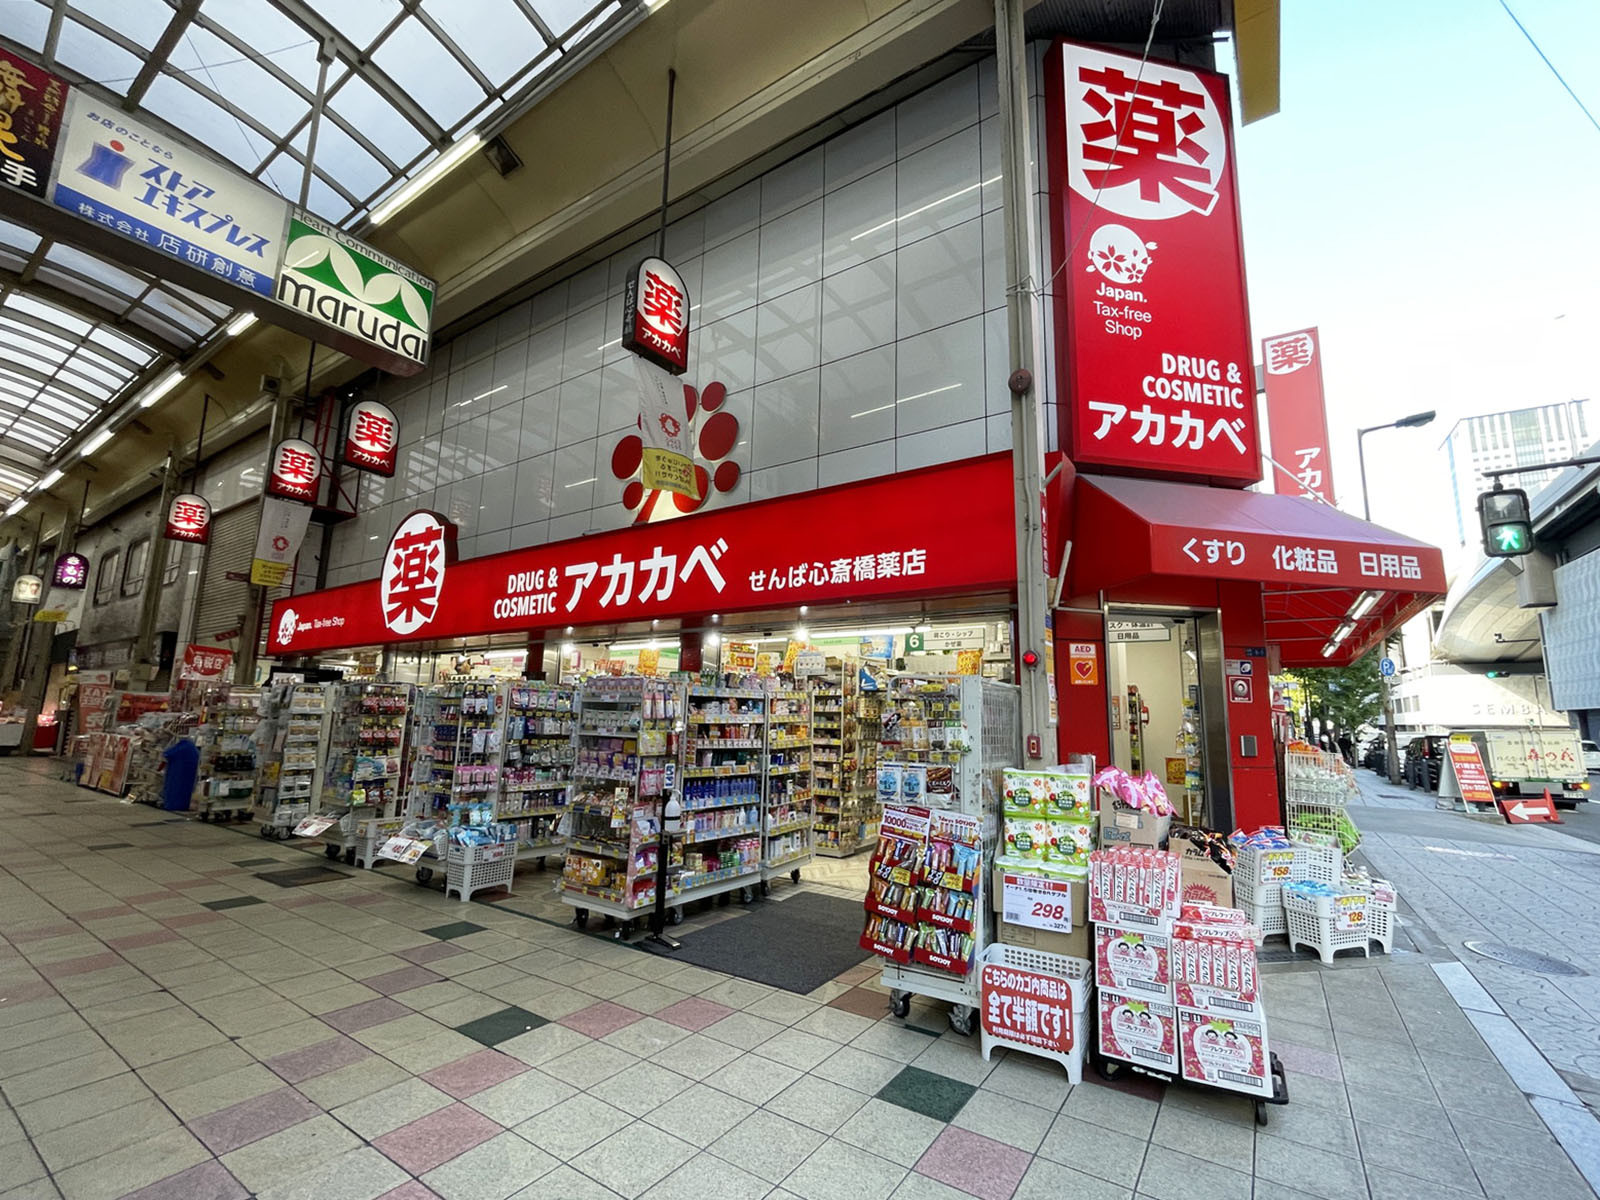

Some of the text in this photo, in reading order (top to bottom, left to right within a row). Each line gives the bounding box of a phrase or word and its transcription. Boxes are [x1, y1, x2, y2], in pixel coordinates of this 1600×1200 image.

[86, 111, 174, 160] お店のことなら
[1078, 66, 1215, 211] 薬
[139, 158, 216, 201] ストア
[133, 182, 271, 258] エキスプレス
[78, 202, 257, 288] 株式会社 店研創意
[293, 207, 436, 290] Heart Communication
[643, 269, 684, 337] 薬
[1096, 282, 1148, 303] Japan.
[1093, 300, 1152, 323] Tax-free
[641, 327, 681, 359] アカカベ
[1105, 320, 1143, 340] Shop
[1161, 353, 1242, 384] DRUG &
[1270, 337, 1309, 371] 薬
[1142, 375, 1245, 409] COSMETIC
[354, 410, 394, 447] 薬
[1088, 401, 1247, 455] アカカベ
[278, 447, 317, 480] 薬
[352, 449, 390, 468] アカカベ
[276, 482, 312, 497] アカカベ
[174, 501, 207, 528] 薬
[387, 525, 445, 624] 薬
[564, 537, 729, 613] アカカベ
[748, 548, 927, 593] せんば心斎橋薬店
[1182, 538, 1421, 580] くすり 化粧品 日用品
[507, 566, 558, 594] DRUG &
[493, 592, 557, 619] COSMETIC
[909, 634, 920, 648] 6
[1074, 645, 1092, 653] AED
[955, 818, 977, 828] SOYJOY
[1272, 866, 1290, 876] 158
[1031, 902, 1064, 920] 298
[1347, 911, 1364, 922] 128
[984, 967, 1067, 1000] こちらのカゴ内商品は
[988, 990, 1071, 1040] 全て半額です!
